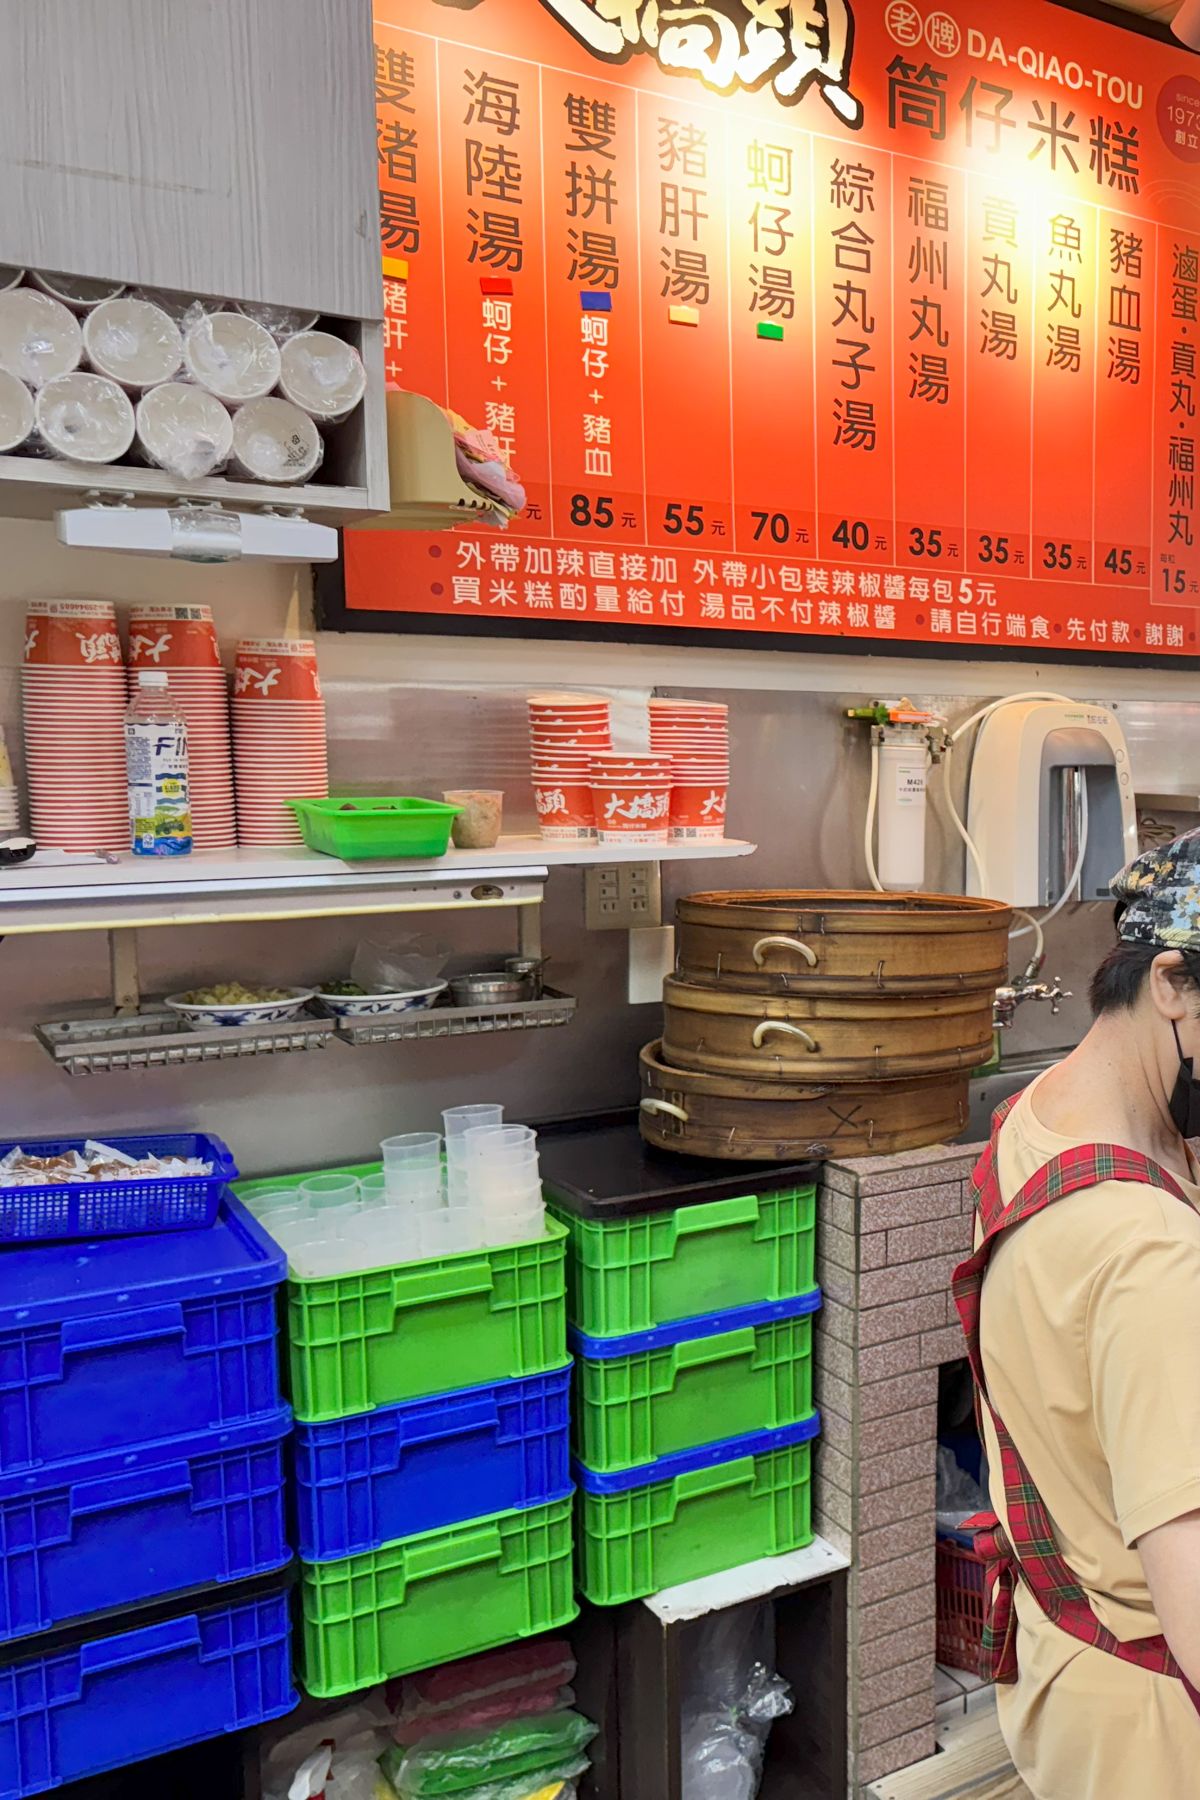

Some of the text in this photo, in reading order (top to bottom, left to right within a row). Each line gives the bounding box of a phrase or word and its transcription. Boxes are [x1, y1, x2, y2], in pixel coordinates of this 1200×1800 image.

[884, 55, 1140, 195] 筒仔米糕
[886, 1, 1143, 110] 老牌 DA-QIAO-TOU
[1175, 91, 1200, 108] since
[462, 68, 523, 273] 海陸湯
[563, 92, 619, 289] 雙拼湯
[656, 115, 711, 305] 豬肝湯
[1174, 129, 1200, 150] 創立
[746, 138, 796, 320] 蚵仔湯
[829, 157, 877, 451] 綜合丸子湯
[907, 176, 950, 405] 福州丸湯
[980, 194, 1019, 362] 貢丸湯
[1045, 212, 1084, 375] 魚丸湯
[1106, 227, 1144, 386] 豬血湯
[450, 575, 686, 618] 買米糕酌量給付
[699, 591, 896, 631] 湯品不付辣椒醬
[930, 608, 1050, 640] 請自行端食
[1066, 616, 1131, 646] 先付款
[1145, 623, 1184, 648] 謝謝
[456, 540, 997, 608] 外帶加辣直接加 外帶小包裝辣椒醬每包5元
